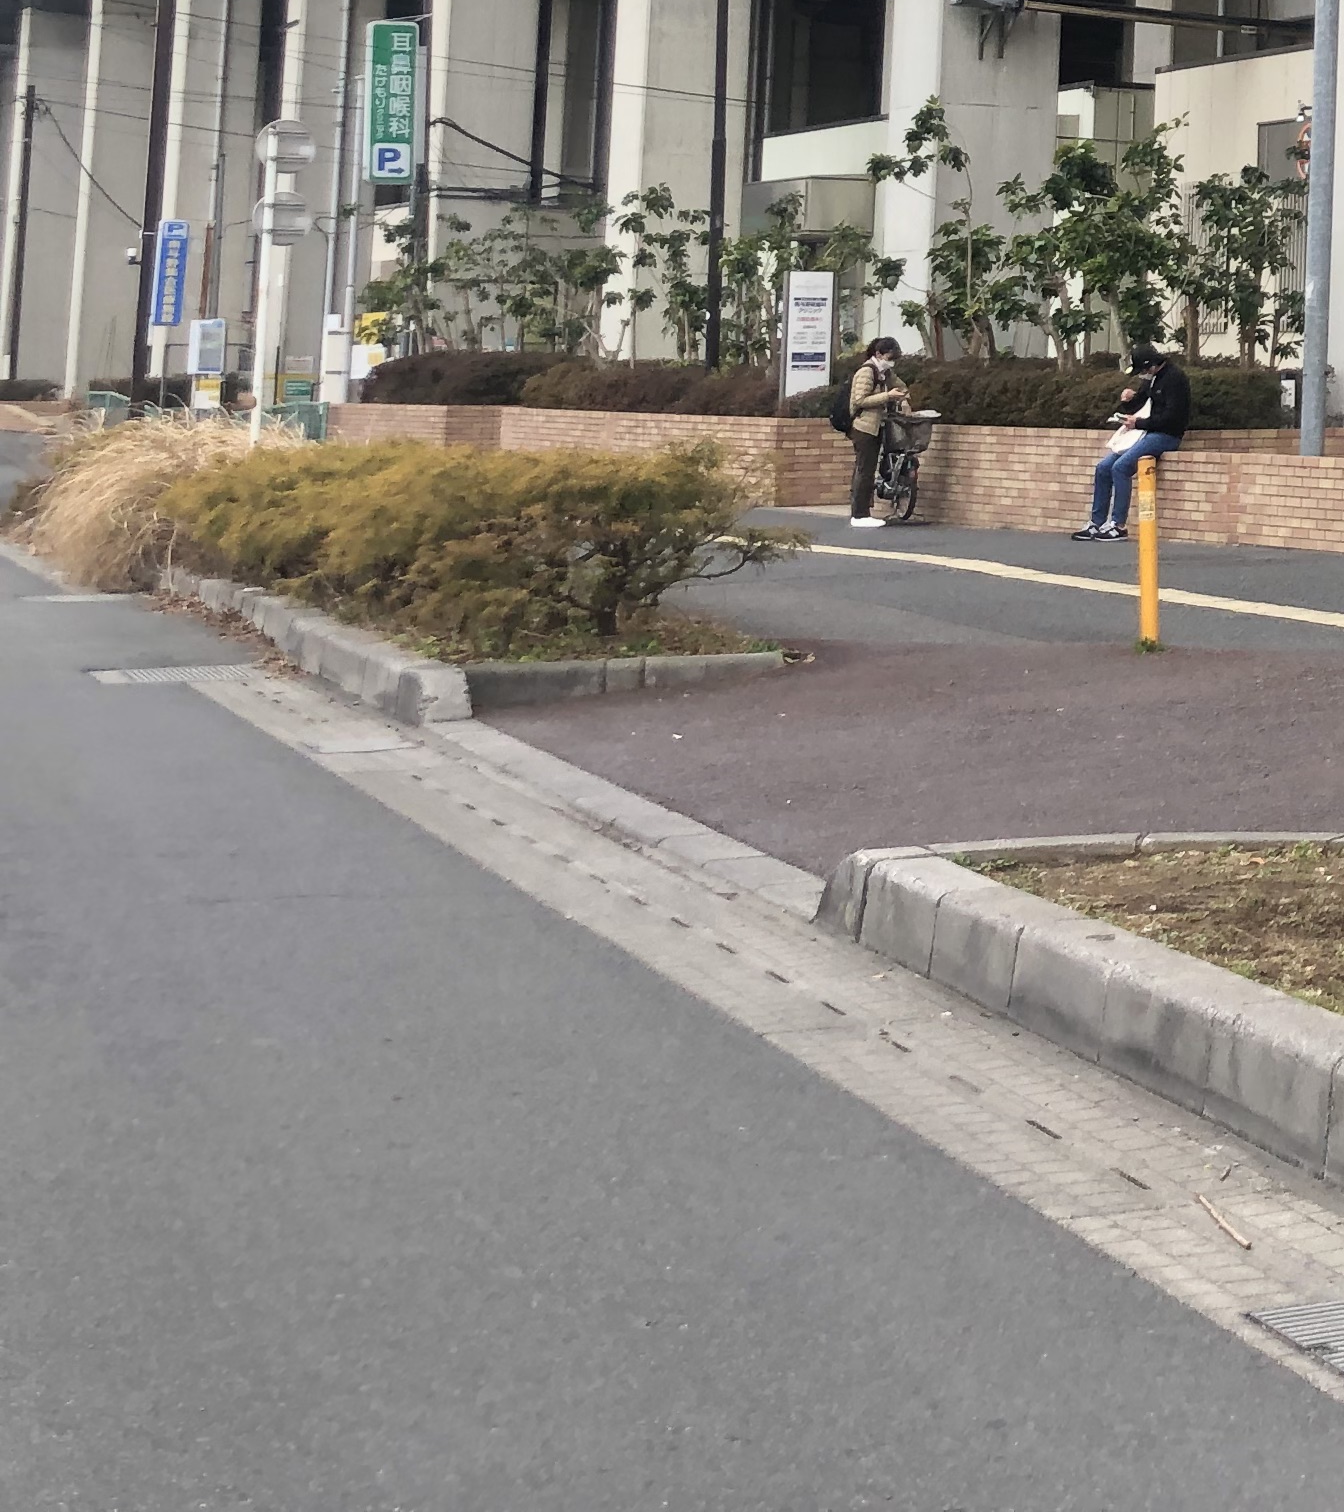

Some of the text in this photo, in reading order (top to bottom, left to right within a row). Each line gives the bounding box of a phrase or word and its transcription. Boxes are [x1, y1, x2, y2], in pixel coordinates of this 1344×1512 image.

[388, 31, 413, 138] 耳鼻咽喉科
[377, 147, 401, 171] P
